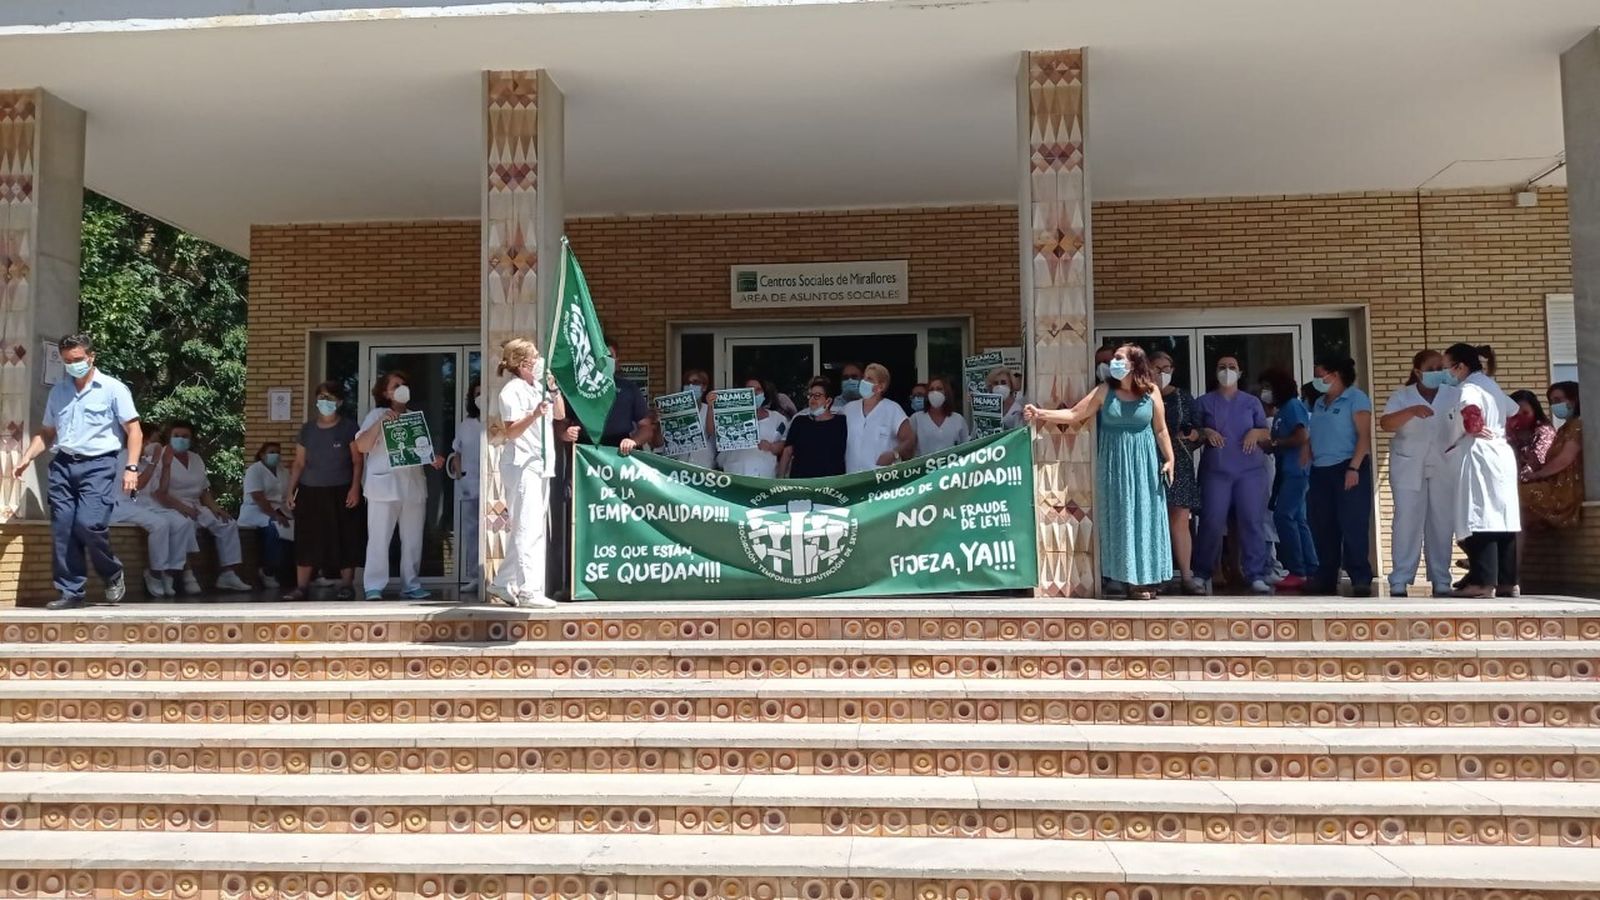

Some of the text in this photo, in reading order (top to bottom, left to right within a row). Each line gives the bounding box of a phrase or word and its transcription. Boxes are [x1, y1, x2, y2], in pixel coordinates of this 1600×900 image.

[760, 275, 797, 287] Centros
[799, 273, 834, 287] Sociales
[836, 274, 848, 286] de
[850, 271, 897, 285] Miraflores
[771, 292, 787, 303] DE
[790, 291, 844, 302] ASUNTOS
[847, 289, 900, 300] SOCIALES
[657, 395, 694, 409] PARAMOS
[715, 391, 752, 402] PARAMOS
[875, 445, 1007, 484] POR UN SERVICIO
[587, 464, 614, 482] NO
[667, 469, 732, 489] ABUSO
[918, 481, 933, 496] DE
[938, 465, 1023, 491] CALIDAD!!!
[600, 486, 636, 500] DE LA
[750, 491, 770, 506] POR
[588, 503, 730, 523] TEMPORALIDAD!!!
[896, 499, 1009, 529] NO AL FRAUDE
[960, 512, 1012, 531] DE LEY!!!
[593, 544, 618, 559] LOS
[621, 545, 649, 559] QUE
[889, 539, 1017, 578] FIJEZA, YA!!!
[585, 561, 721, 584] SE QUEDAN!!!
